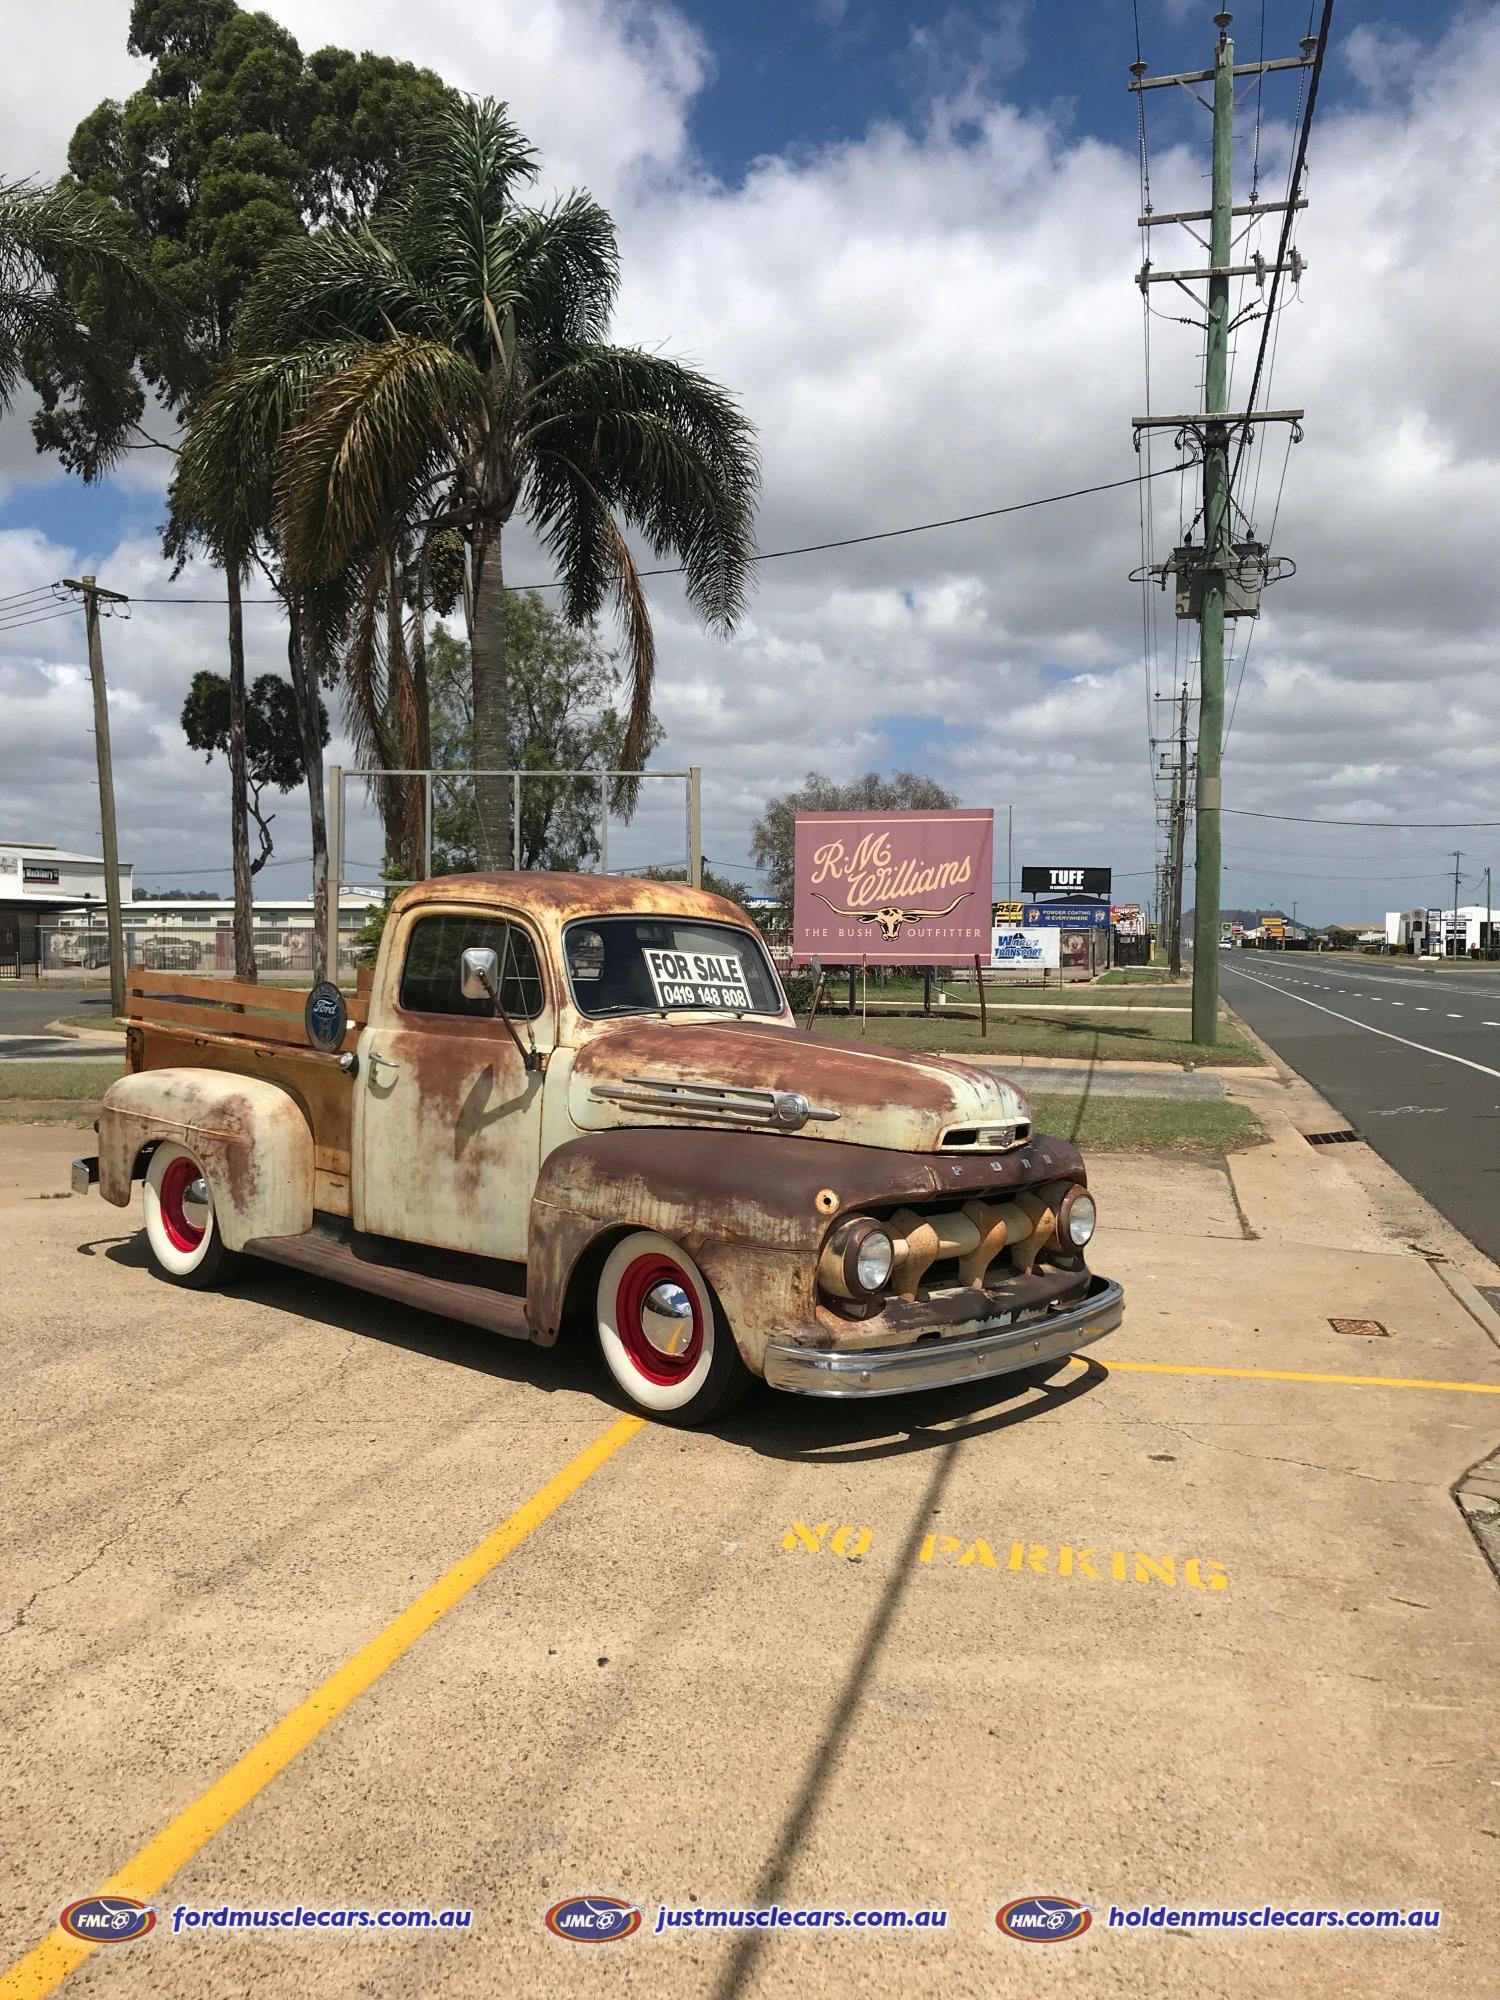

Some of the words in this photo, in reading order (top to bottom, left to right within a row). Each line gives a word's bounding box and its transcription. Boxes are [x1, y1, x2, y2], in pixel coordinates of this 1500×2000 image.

[847, 855, 971, 907] Williams
[1049, 870, 1084, 885] TUFF
[805, 928, 828, 937] THE
[839, 928, 872, 937] BUSH
[907, 928, 981, 938] OUTFITTER
[994, 948, 1043, 957] TRANSPORT
[650, 953, 692, 980] FOR
[694, 956, 742, 983] SALE
[663, 985, 695, 1004] 0419
[698, 986, 721, 1006] 148
[721, 988, 747, 1007] 808
[314, 1000, 338, 1014] Ford
[780, 1520, 874, 1555] NO
[919, 1532, 1229, 1591] PARKING
